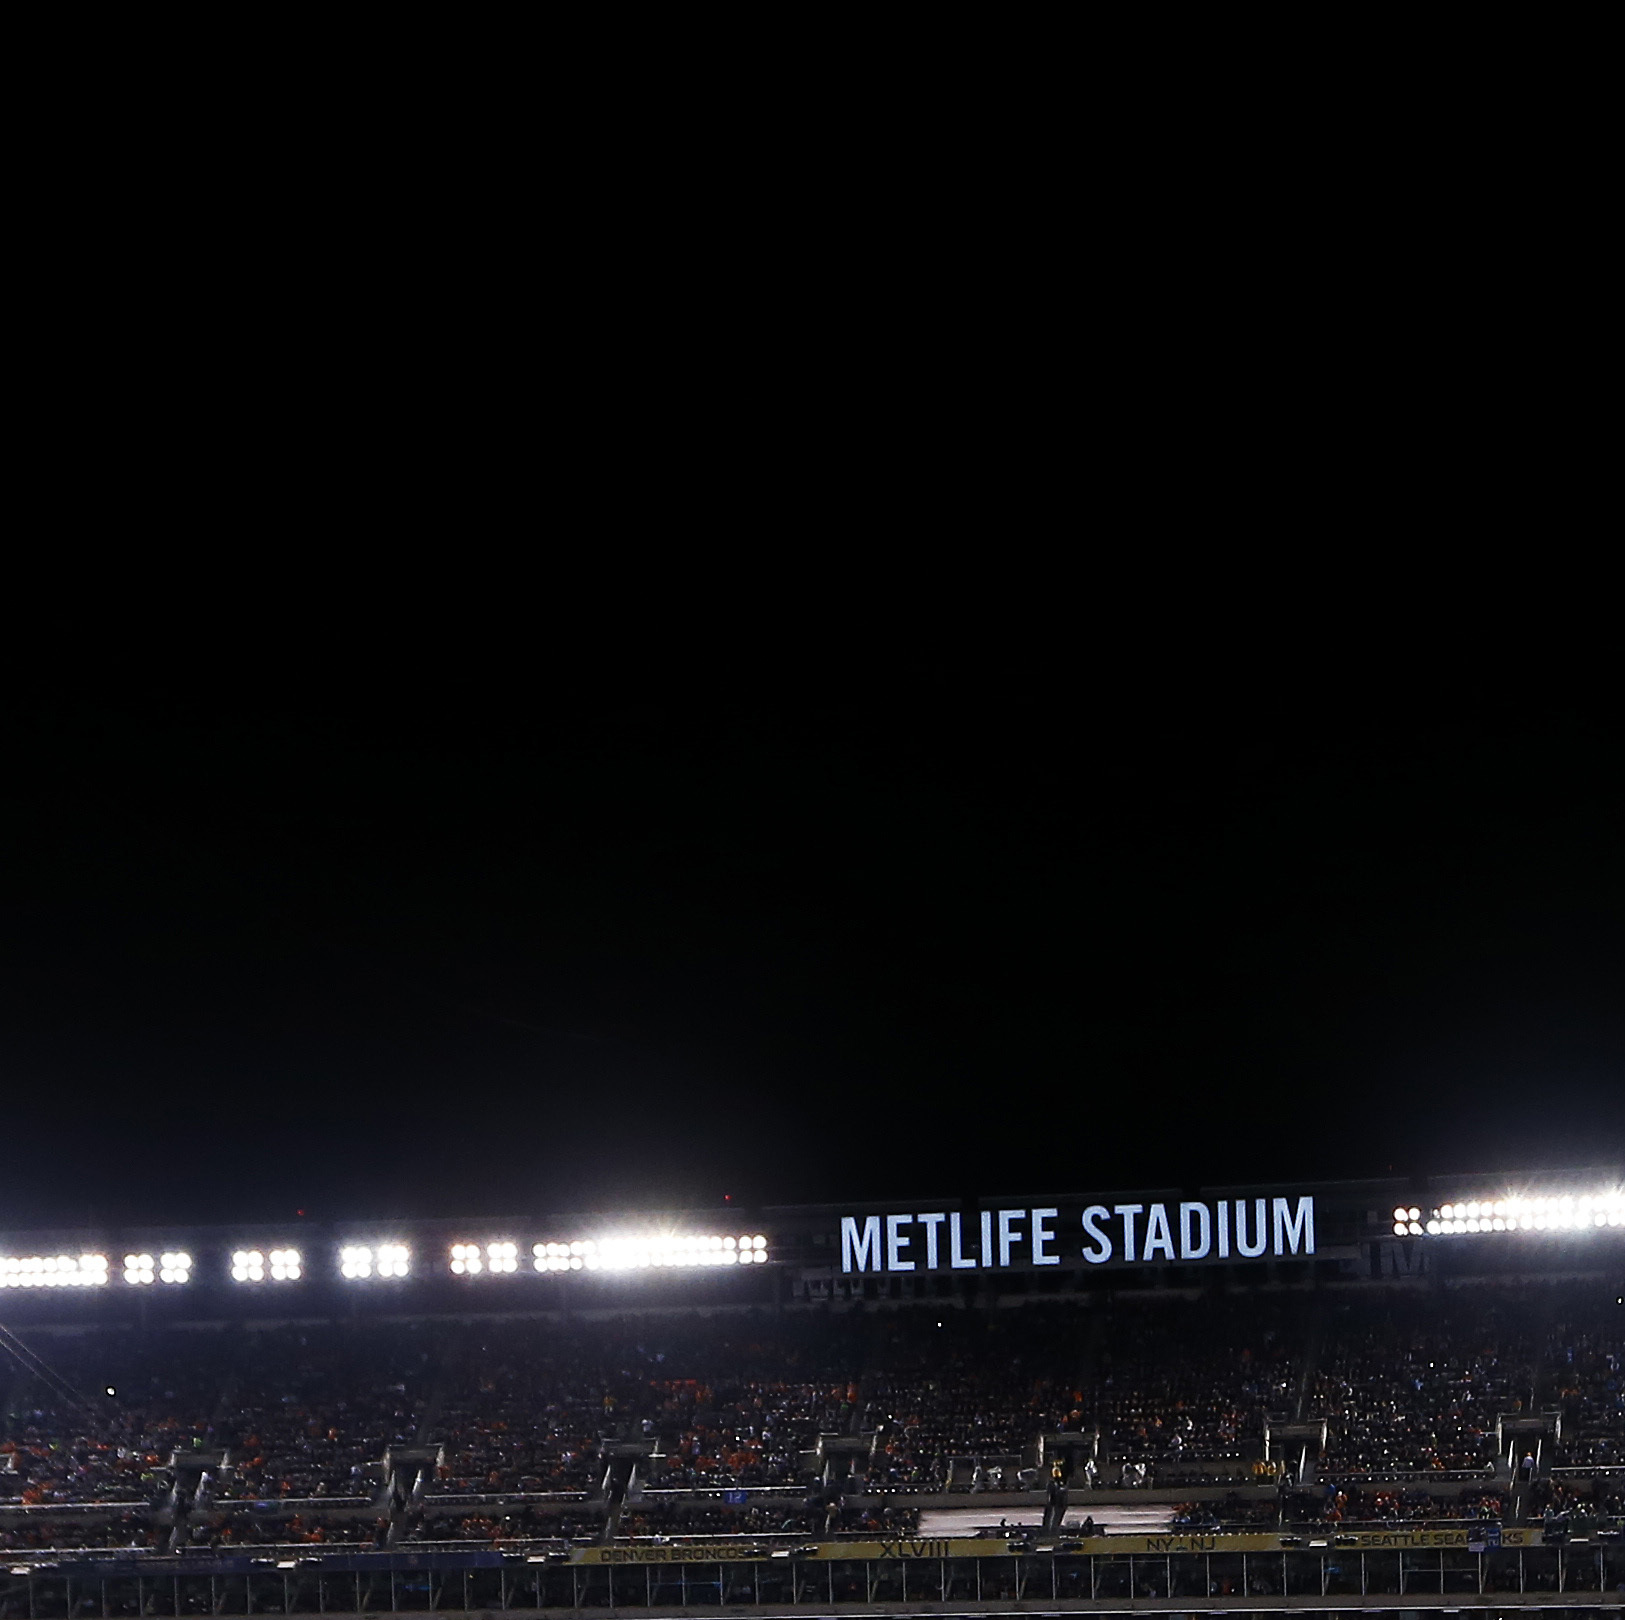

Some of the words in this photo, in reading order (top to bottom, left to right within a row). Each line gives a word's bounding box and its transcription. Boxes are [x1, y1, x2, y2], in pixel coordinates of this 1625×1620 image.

[841, 1207, 1060, 1273] METLIFE
[1082, 1196, 1316, 1265] STADIUM
[1360, 1533, 1431, 1547] SEATTLE
[1434, 1531, 1524, 1546] SEAKS
[601, 1549, 667, 1563] DENVER
[880, 1540, 950, 1558] XLVIII
